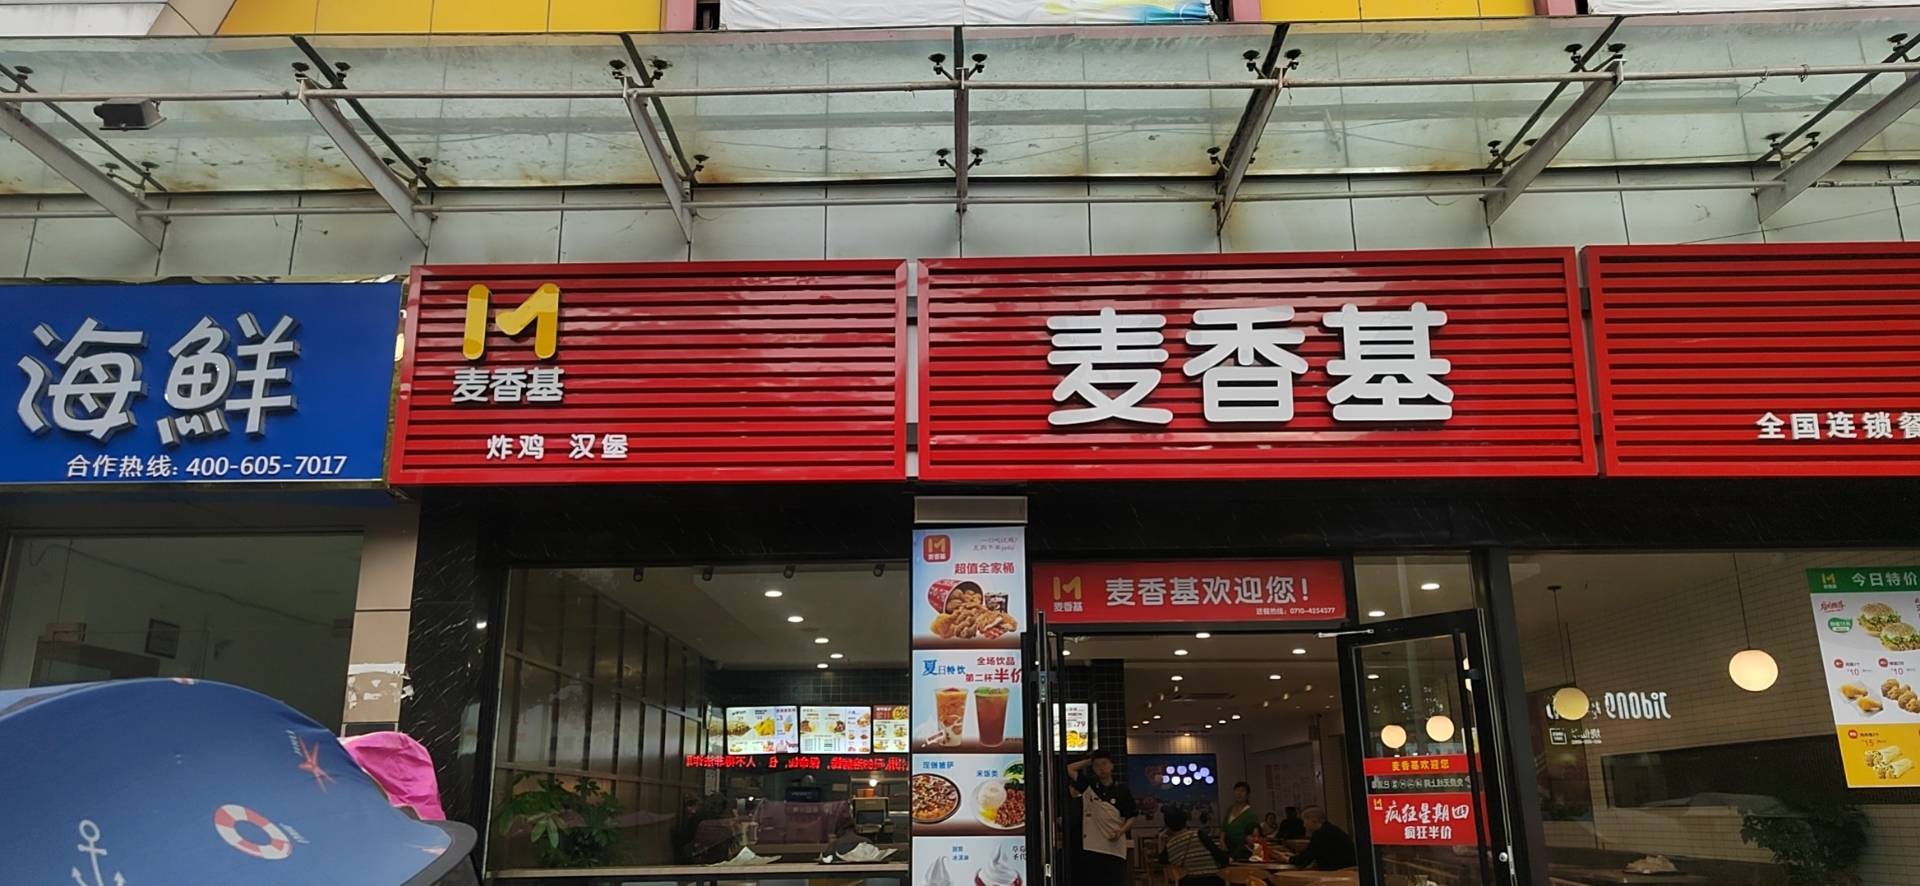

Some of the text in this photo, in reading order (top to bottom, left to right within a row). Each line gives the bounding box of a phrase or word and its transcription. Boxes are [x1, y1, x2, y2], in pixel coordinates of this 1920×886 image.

[1047, 301, 1454, 425] 麦香基
[453, 367, 565, 403] 麦香基
[487, 434, 629, 460] 炸鸡 汉堡
[186, 455, 347, 476] 400-605-7017
[955, 562, 1015, 574] 超值全家桶
[1851, 571, 1918, 587] 今日特价
[977, 656, 1016, 666] 全场饮品
[1392, 759, 1450, 771] 麦香基欢迎您
[1384, 800, 1470, 825] 疯狂星期四
